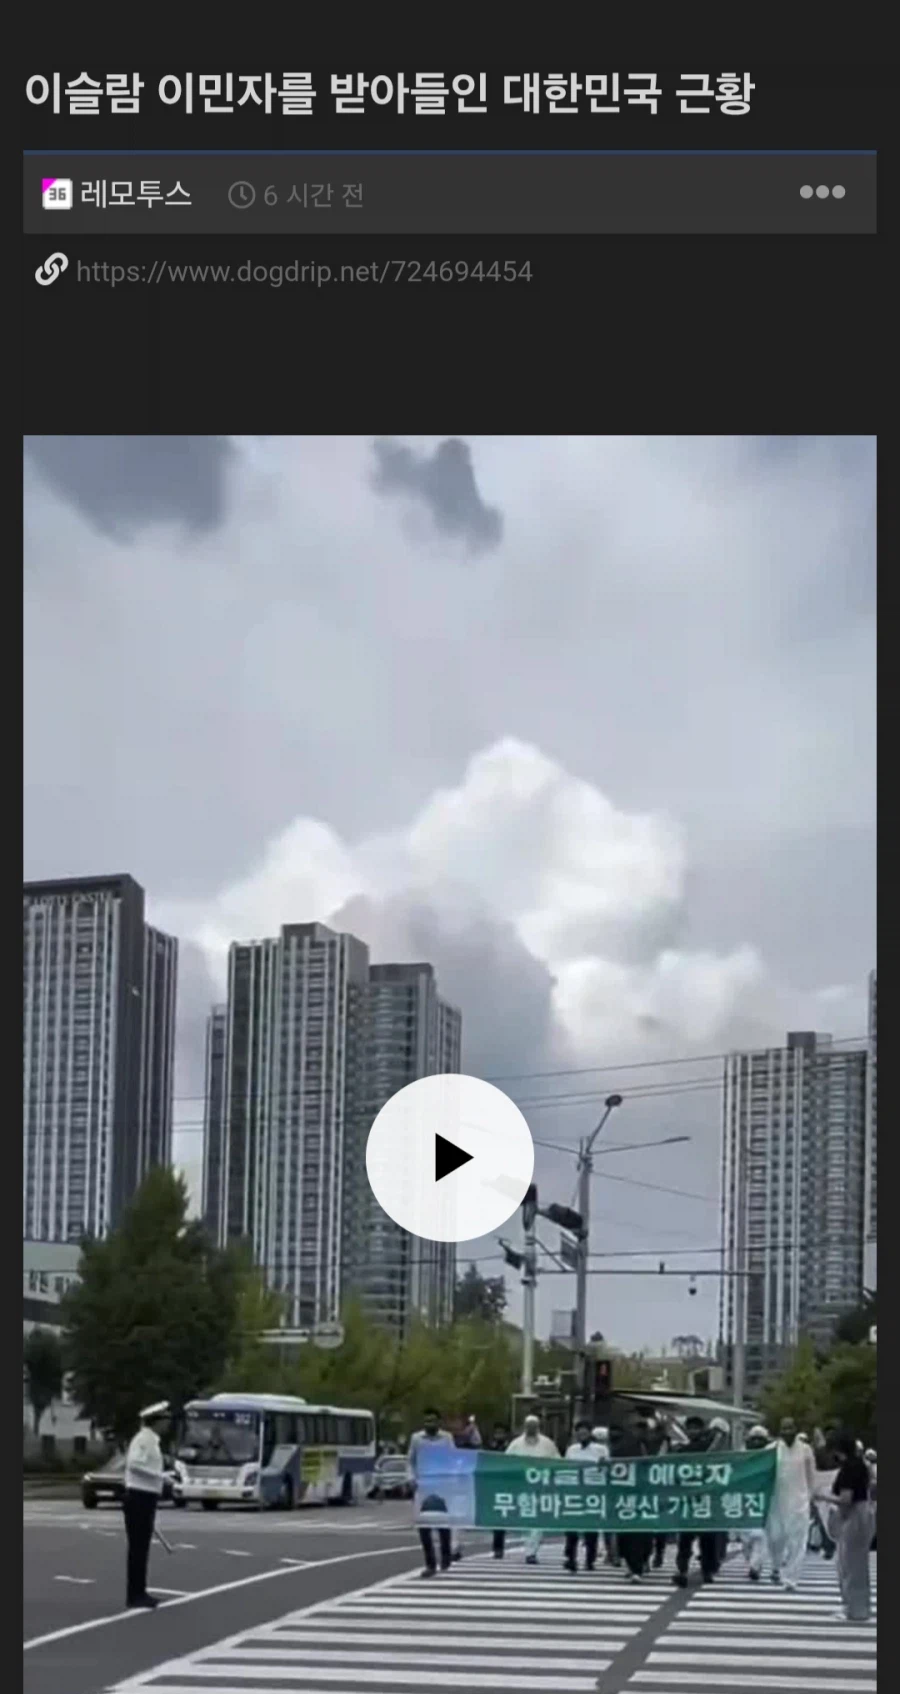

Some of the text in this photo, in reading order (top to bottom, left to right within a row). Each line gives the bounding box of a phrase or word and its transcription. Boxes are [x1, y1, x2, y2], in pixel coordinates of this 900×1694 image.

[25, 71, 756, 116] 이슬람 이민자를 받아들인 대한민국 근황
[80, 179, 193, 209] 레모투스
[264, 183, 363, 208] 6 시간 전
[77, 259, 533, 288] https://www.dogdrip.net/724694454
[649, 1462, 733, 1487] 예언자
[493, 1491, 765, 1520] 무함마드의 생신 기념 행진
